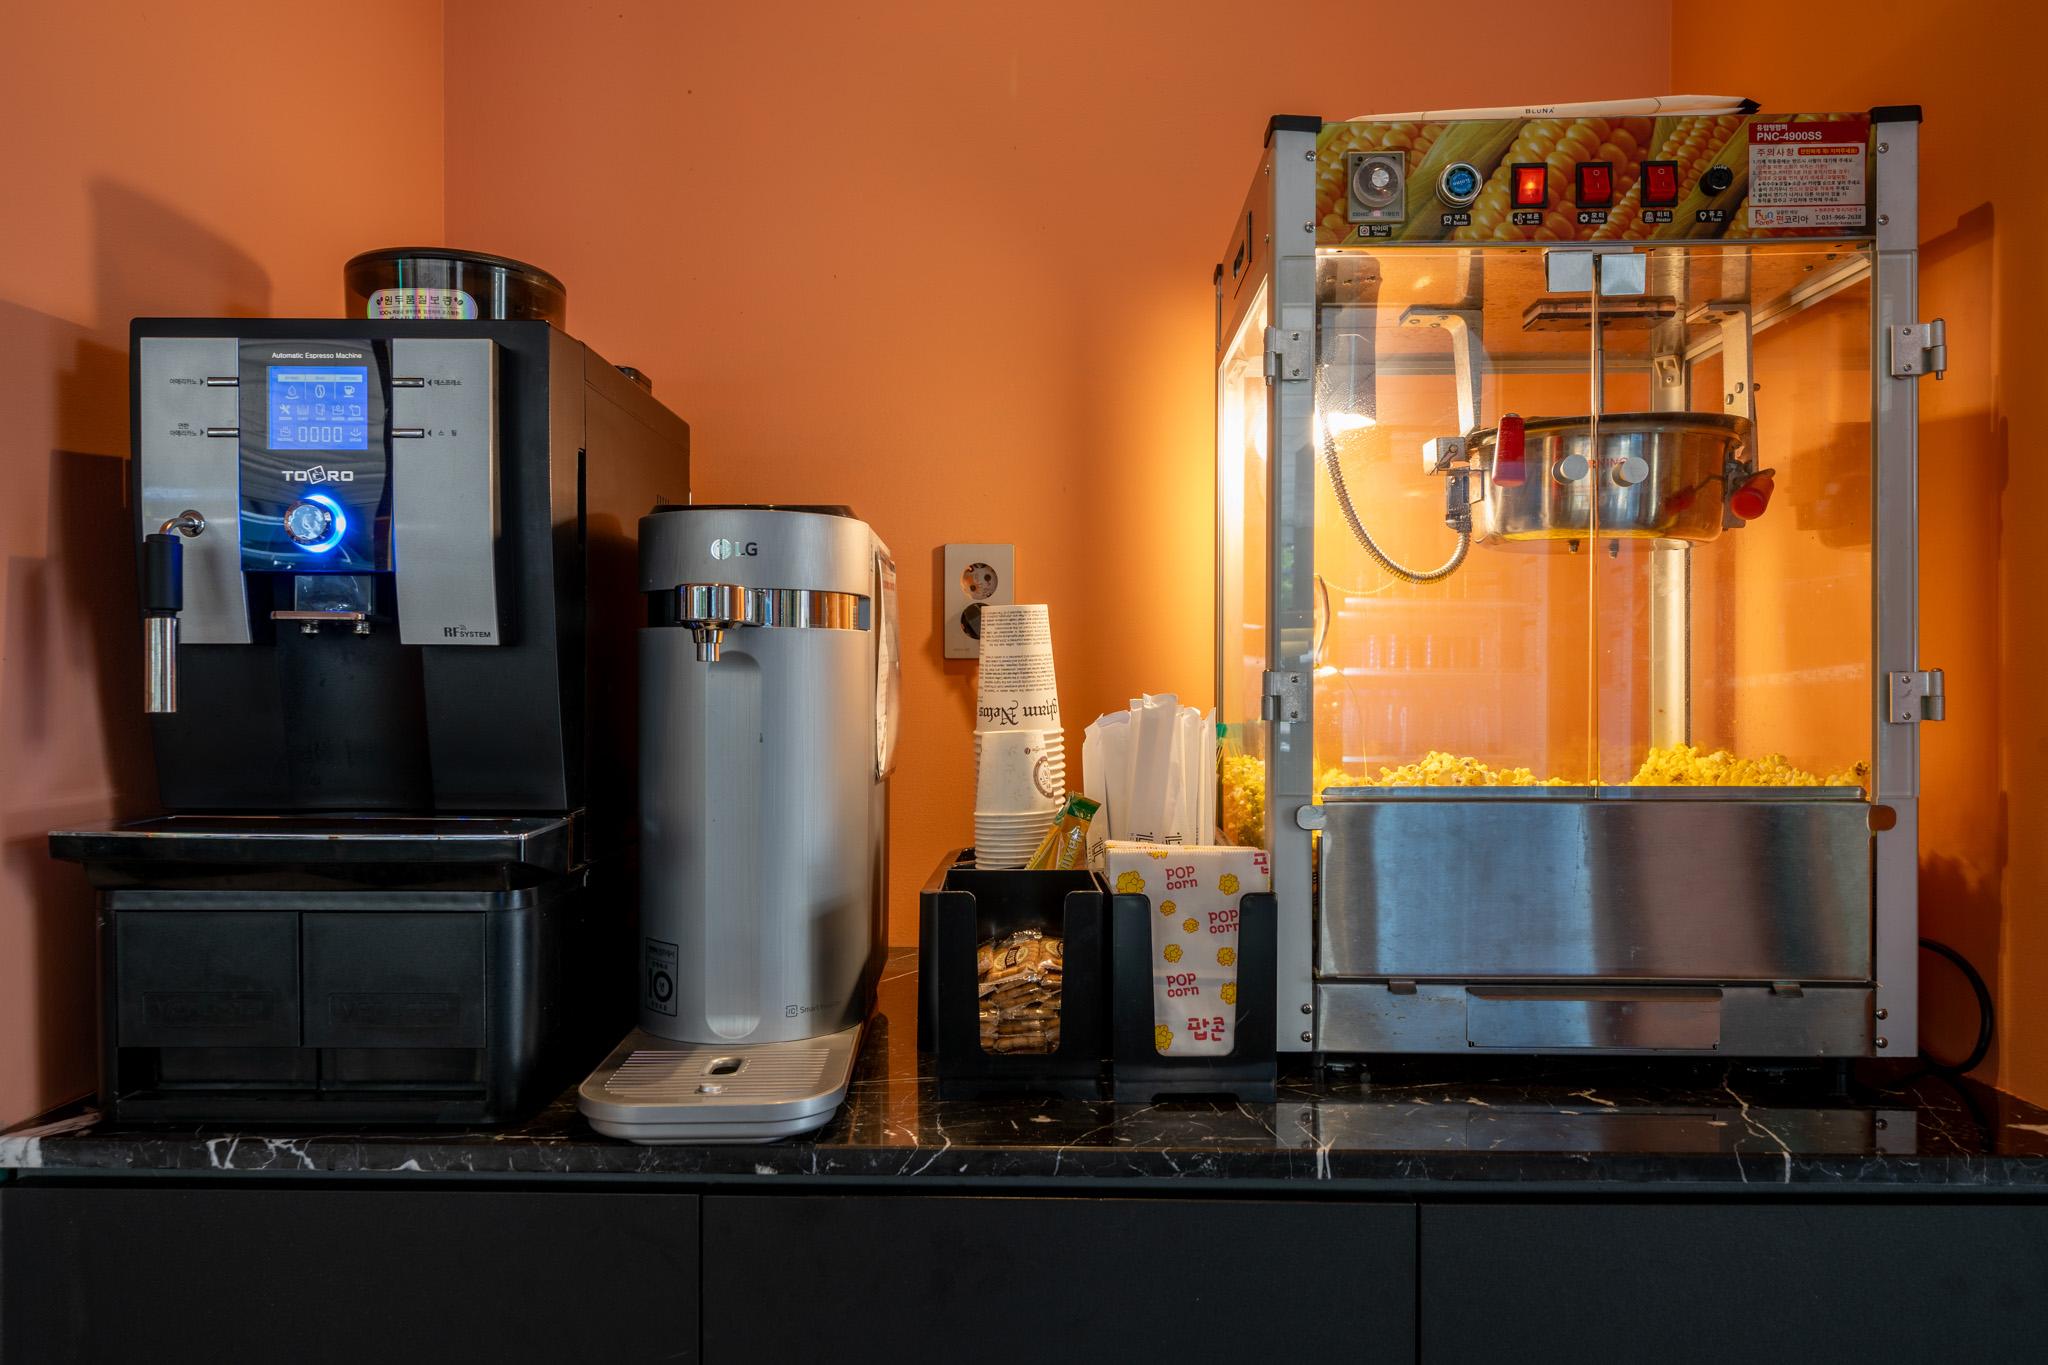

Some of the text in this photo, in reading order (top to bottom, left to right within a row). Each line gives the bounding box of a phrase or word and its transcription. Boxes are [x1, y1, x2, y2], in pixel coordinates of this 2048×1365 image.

[1757, 131, 1822, 141] PNC-4900SS
[1757, 147, 1793, 157] 주의사항
[1776, 215, 1808, 225] 펀코리아
[305, 352, 334, 360] Espresso
[735, 541, 758, 557] LG
[460, 630, 491, 638] SYSTEM
[978, 700, 1020, 726] News
[1165, 866, 1195, 881] POP
[1166, 878, 1198, 891] corn
[1208, 909, 1238, 925] POP
[1166, 972, 1197, 988] POP
[1167, 985, 1200, 998] corn
[1187, 1016, 1226, 1042] 팝콘
